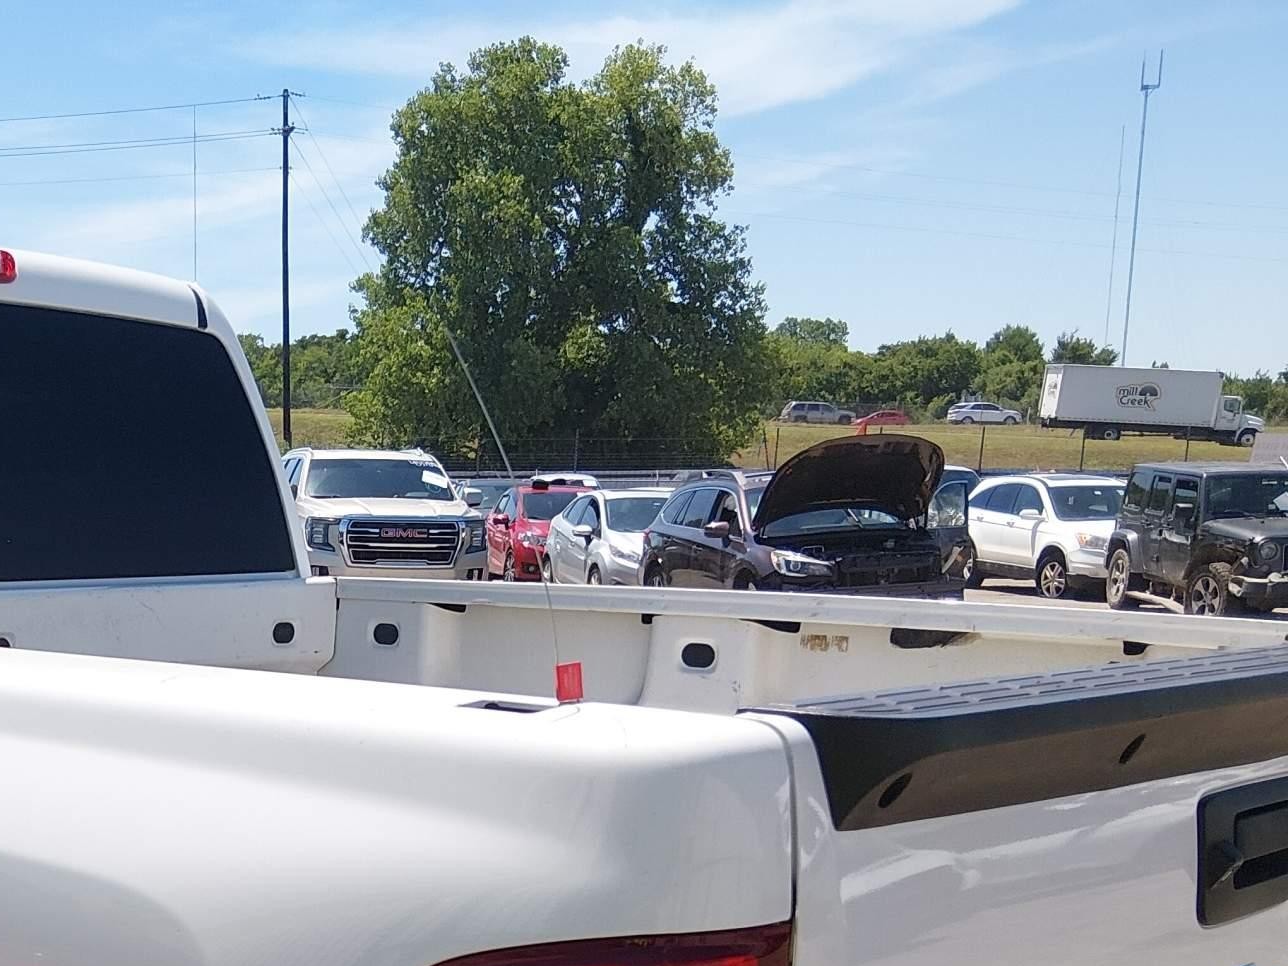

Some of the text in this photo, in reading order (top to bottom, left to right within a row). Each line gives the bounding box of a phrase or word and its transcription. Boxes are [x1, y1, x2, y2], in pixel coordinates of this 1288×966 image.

[1119, 387, 1138, 395] mill
[1120, 396, 1151, 408] Creek
[381, 527, 428, 538] GMC
